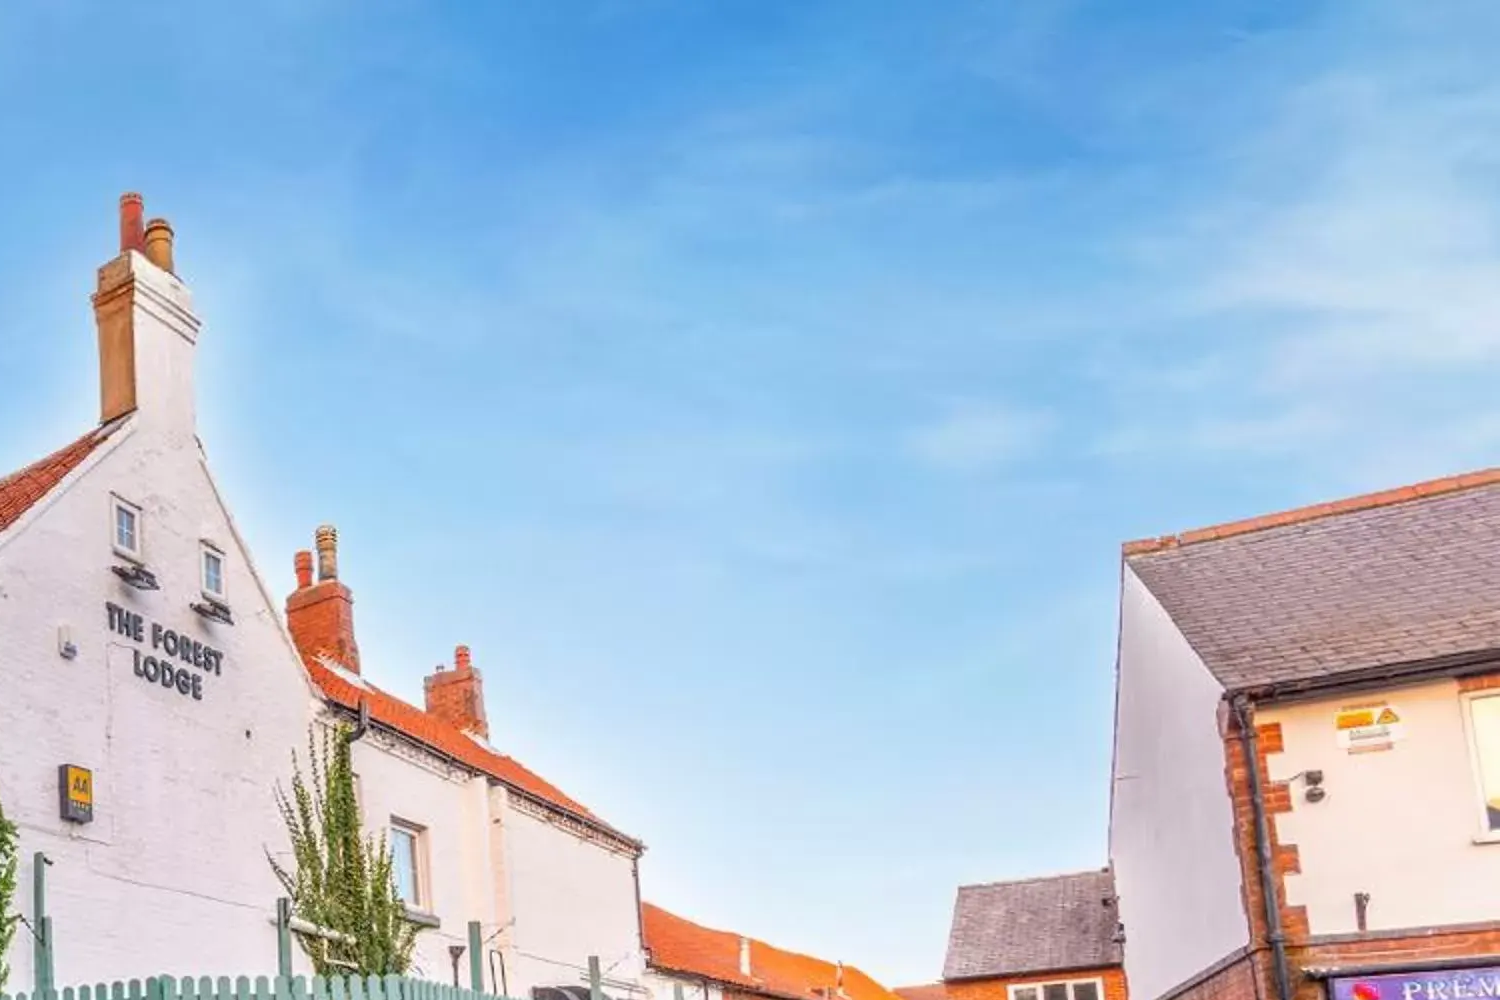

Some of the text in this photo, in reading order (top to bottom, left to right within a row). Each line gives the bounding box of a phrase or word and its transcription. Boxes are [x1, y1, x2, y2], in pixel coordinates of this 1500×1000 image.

[105, 601, 223, 676] THE FOREST
[133, 649, 202, 700] LODGE
[73, 775, 88, 792] AA
